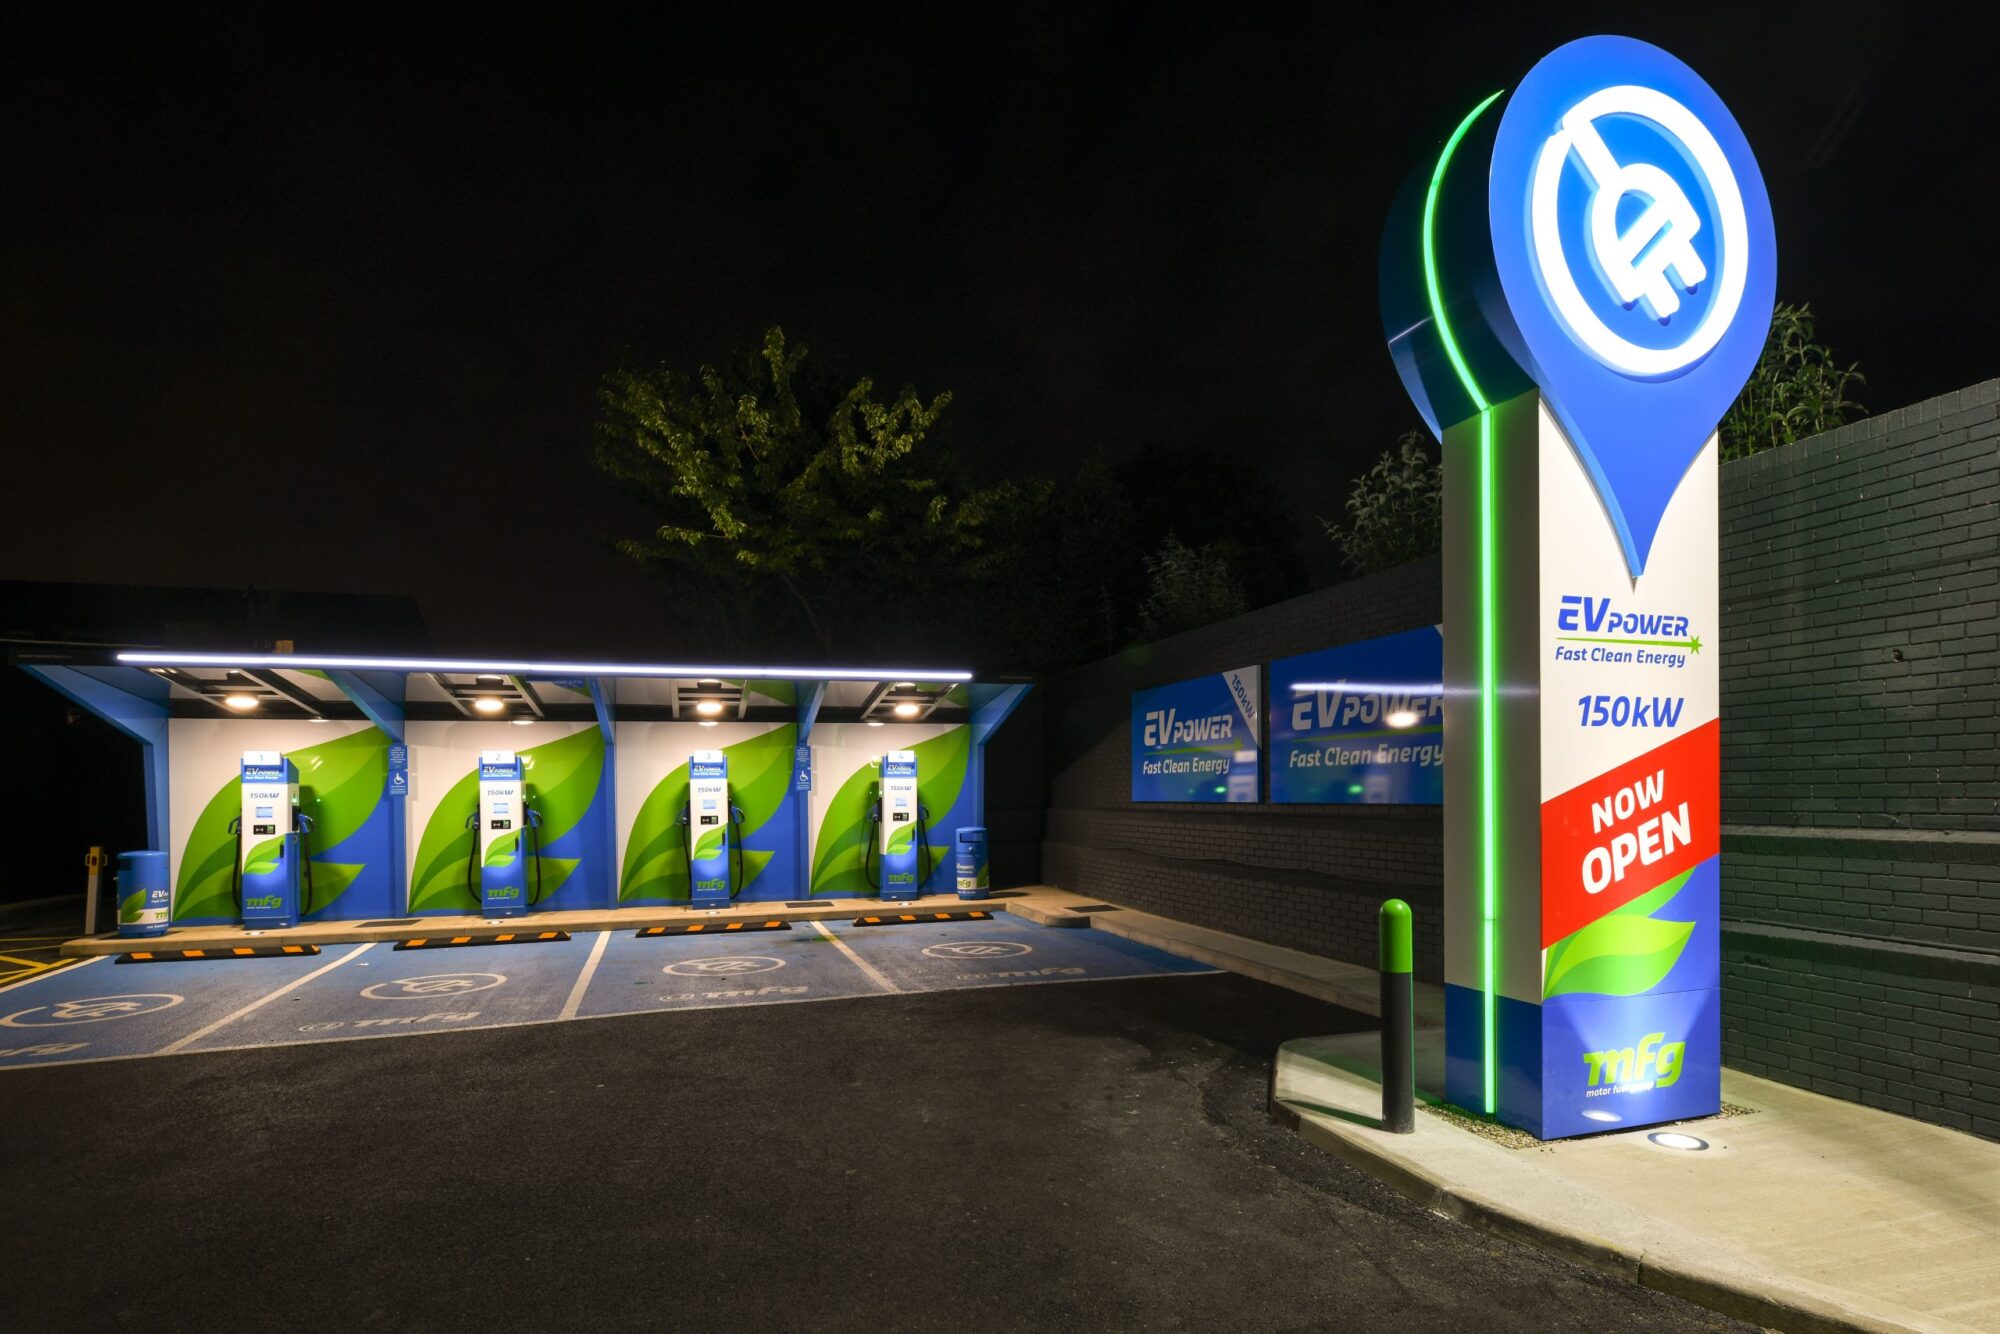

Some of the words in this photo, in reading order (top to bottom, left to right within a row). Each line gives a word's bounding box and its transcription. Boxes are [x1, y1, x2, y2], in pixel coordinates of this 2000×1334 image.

[1557, 595, 1610, 632] EV
[1608, 613, 1689, 637] POWER
[1555, 646, 1587, 661] Fast
[1591, 647, 1632, 663] Clean
[1636, 652, 1686, 668] Energy
[1232, 674, 1256, 719] 150kW
[1292, 679, 1346, 731] EV
[1578, 695, 1684, 728] 150kW
[1144, 708, 1176, 746] EV
[1173, 714, 1233, 743] POWER
[1143, 761, 1161, 775] Fast
[1163, 758, 1189, 773] Clean
[1193, 757, 1230, 775] Energy
[1289, 750, 1321, 768] Fast
[1325, 747, 1371, 766] Clean
[1377, 744, 1444, 767] Energy
[1591, 769, 1664, 834] NOW
[1581, 802, 1692, 895] OPEN
[487, 886, 520, 899] mfg
[696, 878, 725, 890] mfg
[246, 895, 282, 908] mfg
[1583, 1032, 1686, 1088] mfg
[1586, 1087, 1611, 1098] motor
